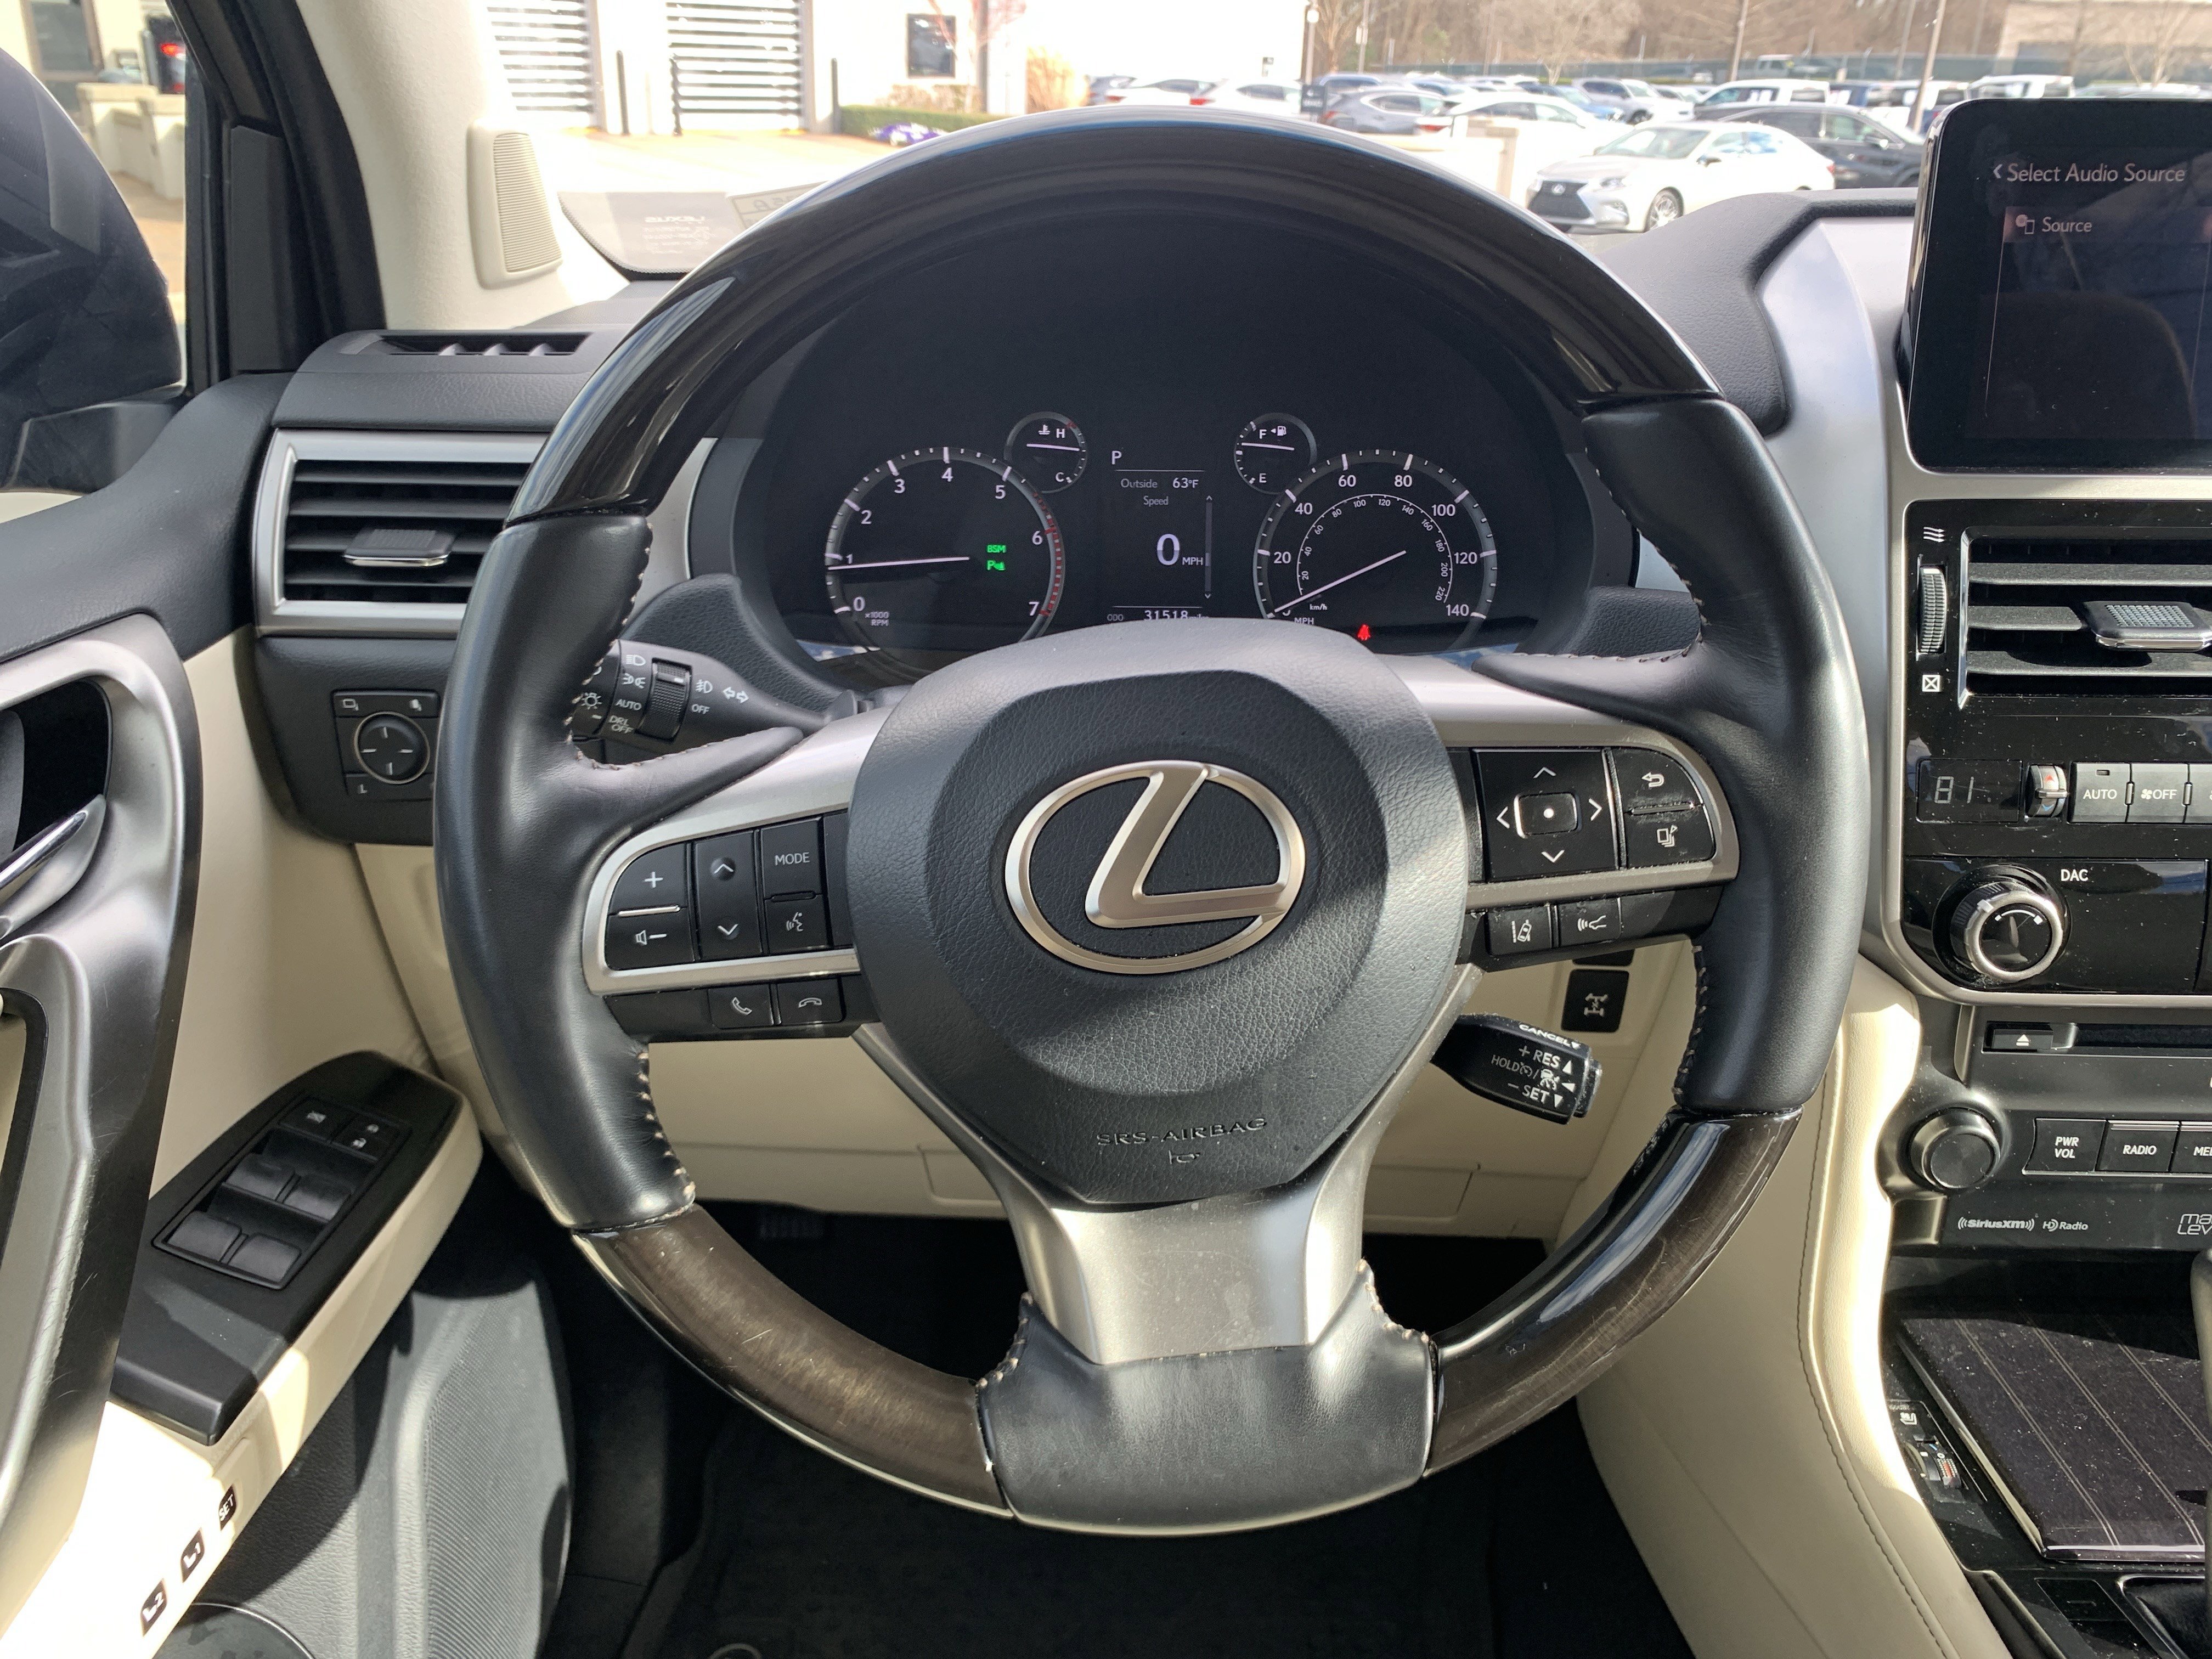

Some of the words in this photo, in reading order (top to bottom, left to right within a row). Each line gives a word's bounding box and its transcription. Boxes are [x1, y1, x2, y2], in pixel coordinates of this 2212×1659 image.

[2007, 163, 2061, 182] Select
[2066, 163, 2118, 182] Audio
[2124, 163, 2186, 182] Source
[2041, 217, 2092, 234] Source
[1056, 428, 1065, 438] H
[1259, 429, 1267, 439] F
[1111, 450, 1122, 465] P
[941, 467, 954, 482] 4
[1055, 472, 1065, 483] C
[1259, 473, 1267, 483] E
[1338, 474, 1357, 488] 60
[1393, 474, 1413, 488] 80
[894, 479, 906, 494] 3
[1120, 477, 1158, 489] Outside
[995, 485, 1006, 500] 5
[1143, 495, 1169, 506] Speed
[1353, 499, 1367, 509] 100
[1378, 498, 1391, 507] 120
[1295, 502, 1313, 515] 40
[1331, 507, 1342, 518] 80
[1401, 504, 1415, 516] 140
[1431, 504, 1457, 517] 100
[860, 510, 872, 525] 2
[1314, 524, 1324, 536] 60
[1421, 518, 1434, 532] 160
[1031, 530, 1043, 545] 6
[987, 545, 1006, 553] BSM
[1156, 533, 1180, 566] 0
[1181, 556, 1204, 566] MPH
[1304, 546, 1313, 557] 40
[1434, 539, 1446, 553] 180
[845, 554, 853, 564] 1
[1273, 551, 1292, 565] 20
[1453, 551, 1479, 565] 120
[1301, 570, 1310, 580] 20
[1440, 562, 1449, 578] 200
[1435, 585, 1446, 601] 220
[853, 596, 865, 612] 0
[1029, 601, 1040, 617] 7
[1445, 603, 1470, 617] 140
[871, 618, 889, 627] RPM
[1107, 613, 1124, 622] ODO
[1144, 610, 1189, 620] 31518
[1294, 617, 1314, 625] MPH
[615, 698, 642, 712] AUTO
[691, 703, 710, 714] OFF
[608, 715, 630, 726] DRL
[611, 724, 634, 734] OFF
[1934, 776, 1975, 804] 81
[2083, 789, 2118, 800] AUTO
[2152, 789, 2178, 800] OFF
[774, 851, 811, 866] MODE
[2061, 868, 2089, 882] DAC
[1519, 1024, 1571, 1047] CANCEL
[1491, 1054, 1521, 1071] HOLD
[1532, 1049, 1561, 1068] RES
[1521, 1085, 1550, 1104] SET
[2054, 1136, 2080, 1147] PWR
[2053, 1148, 2076, 1159] VOL
[2122, 1144, 2157, 1156] RADIO
[2059, 1221, 2089, 1231] Radio
[219, 1493, 234, 1522] SET
